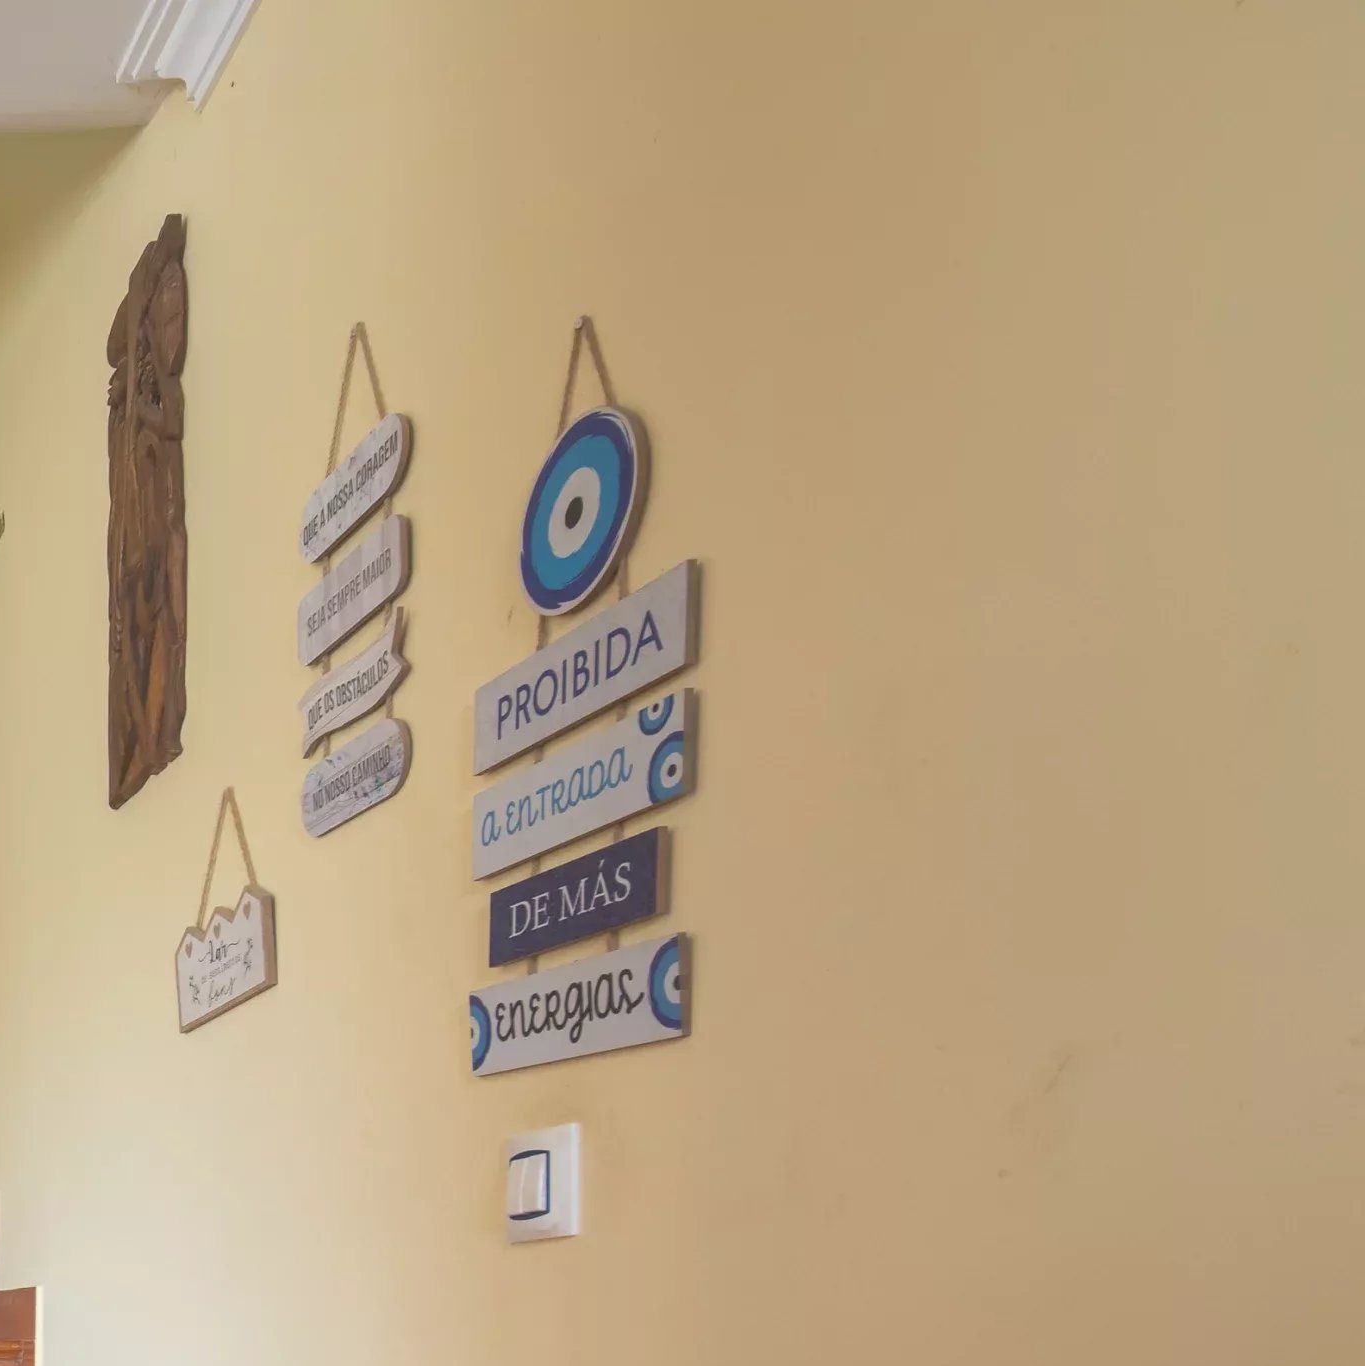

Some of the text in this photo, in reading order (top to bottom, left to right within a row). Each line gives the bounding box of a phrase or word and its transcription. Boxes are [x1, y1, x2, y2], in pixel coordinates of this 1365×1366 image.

[302, 430, 399, 547] QUE A NOSSA CORAGEM
[307, 547, 392, 637] SEJA SEMPRE MAIOR
[306, 650, 390, 731] QUE OS OBSTÁCULOS
[497, 608, 664, 741] PROIBIDA
[311, 745, 391, 813] NO NOSSO CAMINHO
[508, 859, 632, 939] DE MÁS
